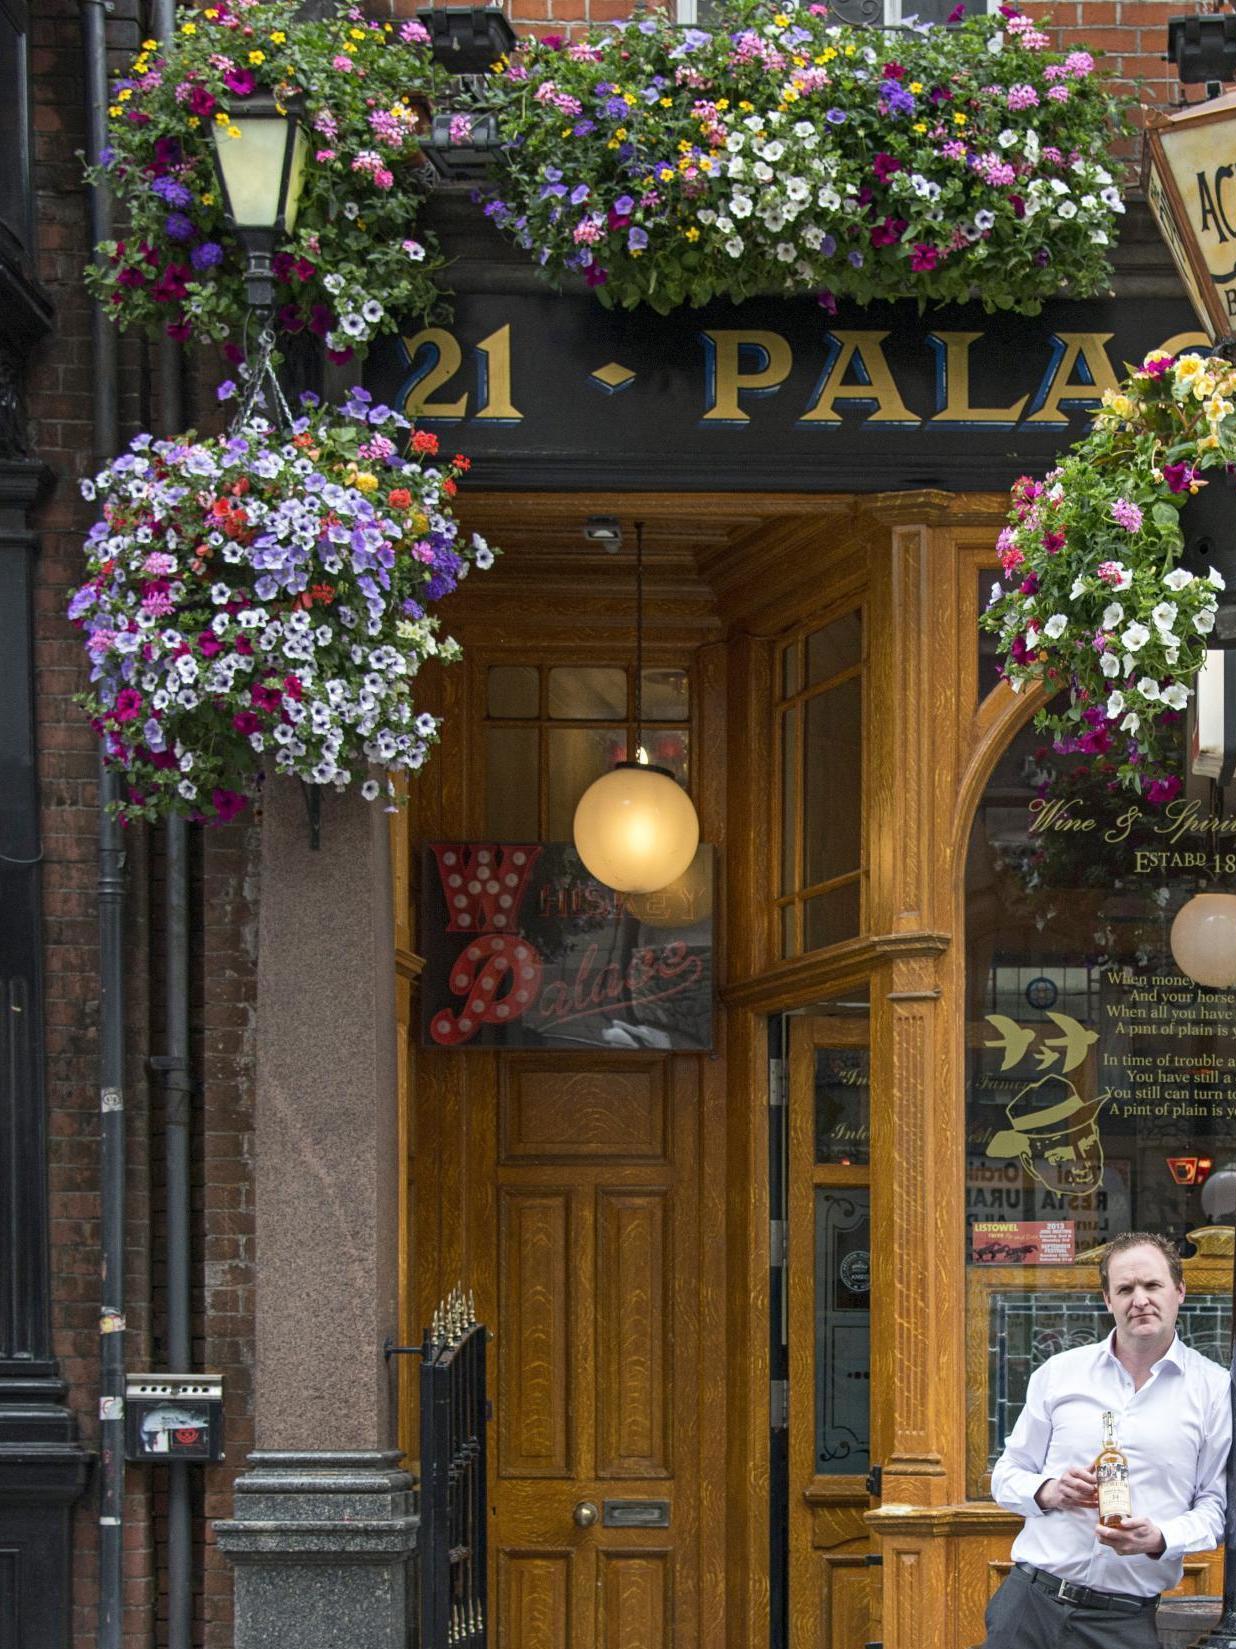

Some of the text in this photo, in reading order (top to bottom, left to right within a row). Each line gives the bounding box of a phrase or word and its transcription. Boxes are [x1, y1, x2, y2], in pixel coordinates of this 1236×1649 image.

[399, 323, 524, 424] 21
[1029, 799, 1096, 832] Wine
[1104, 806, 1142, 843] &
[1107, 972, 1147, 985] When
[1131, 987, 1157, 1001] And
[1161, 993, 1194, 1005] your
[1198, 990, 1235, 1003] horse
[1107, 1005, 1146, 1018] When
[1151, 1005, 1167, 1018] all
[1172, 1009, 1196, 1022] you
[1201, 1006, 1232, 1020] have
[1115, 1022, 1125, 1034] A
[1129, 1023, 1156, 1037] pint
[1161, 1022, 1176, 1035] of
[1178, 1022, 1214, 1038] plain
[1217, 1023, 1229, 1036] is
[1103, 1053, 1118, 1066] In
[1122, 1053, 1153, 1066] time
[1157, 1053, 1172, 1066] of
[1174, 1053, 1223, 1067] trouble
[1127, 1070, 1153, 1083] You
[1158, 1069, 1190, 1083] have
[1194, 1069, 1219, 1084] still
[1223, 1075, 1232, 1084] a
[1105, 1086, 1131, 1099] You
[1135, 1086, 1161, 1099] still
[1164, 1090, 1189, 1100] can
[1194, 1089, 1223, 1100] turn
[1109, 1103, 1119, 1115] A
[1124, 1103, 1151, 1118] pint
[1155, 1103, 1171, 1116] of
[1173, 1103, 1207, 1119] plain
[1212, 1104, 1223, 1116] is
[974, 1223, 1018, 1232] LISTOWEL
